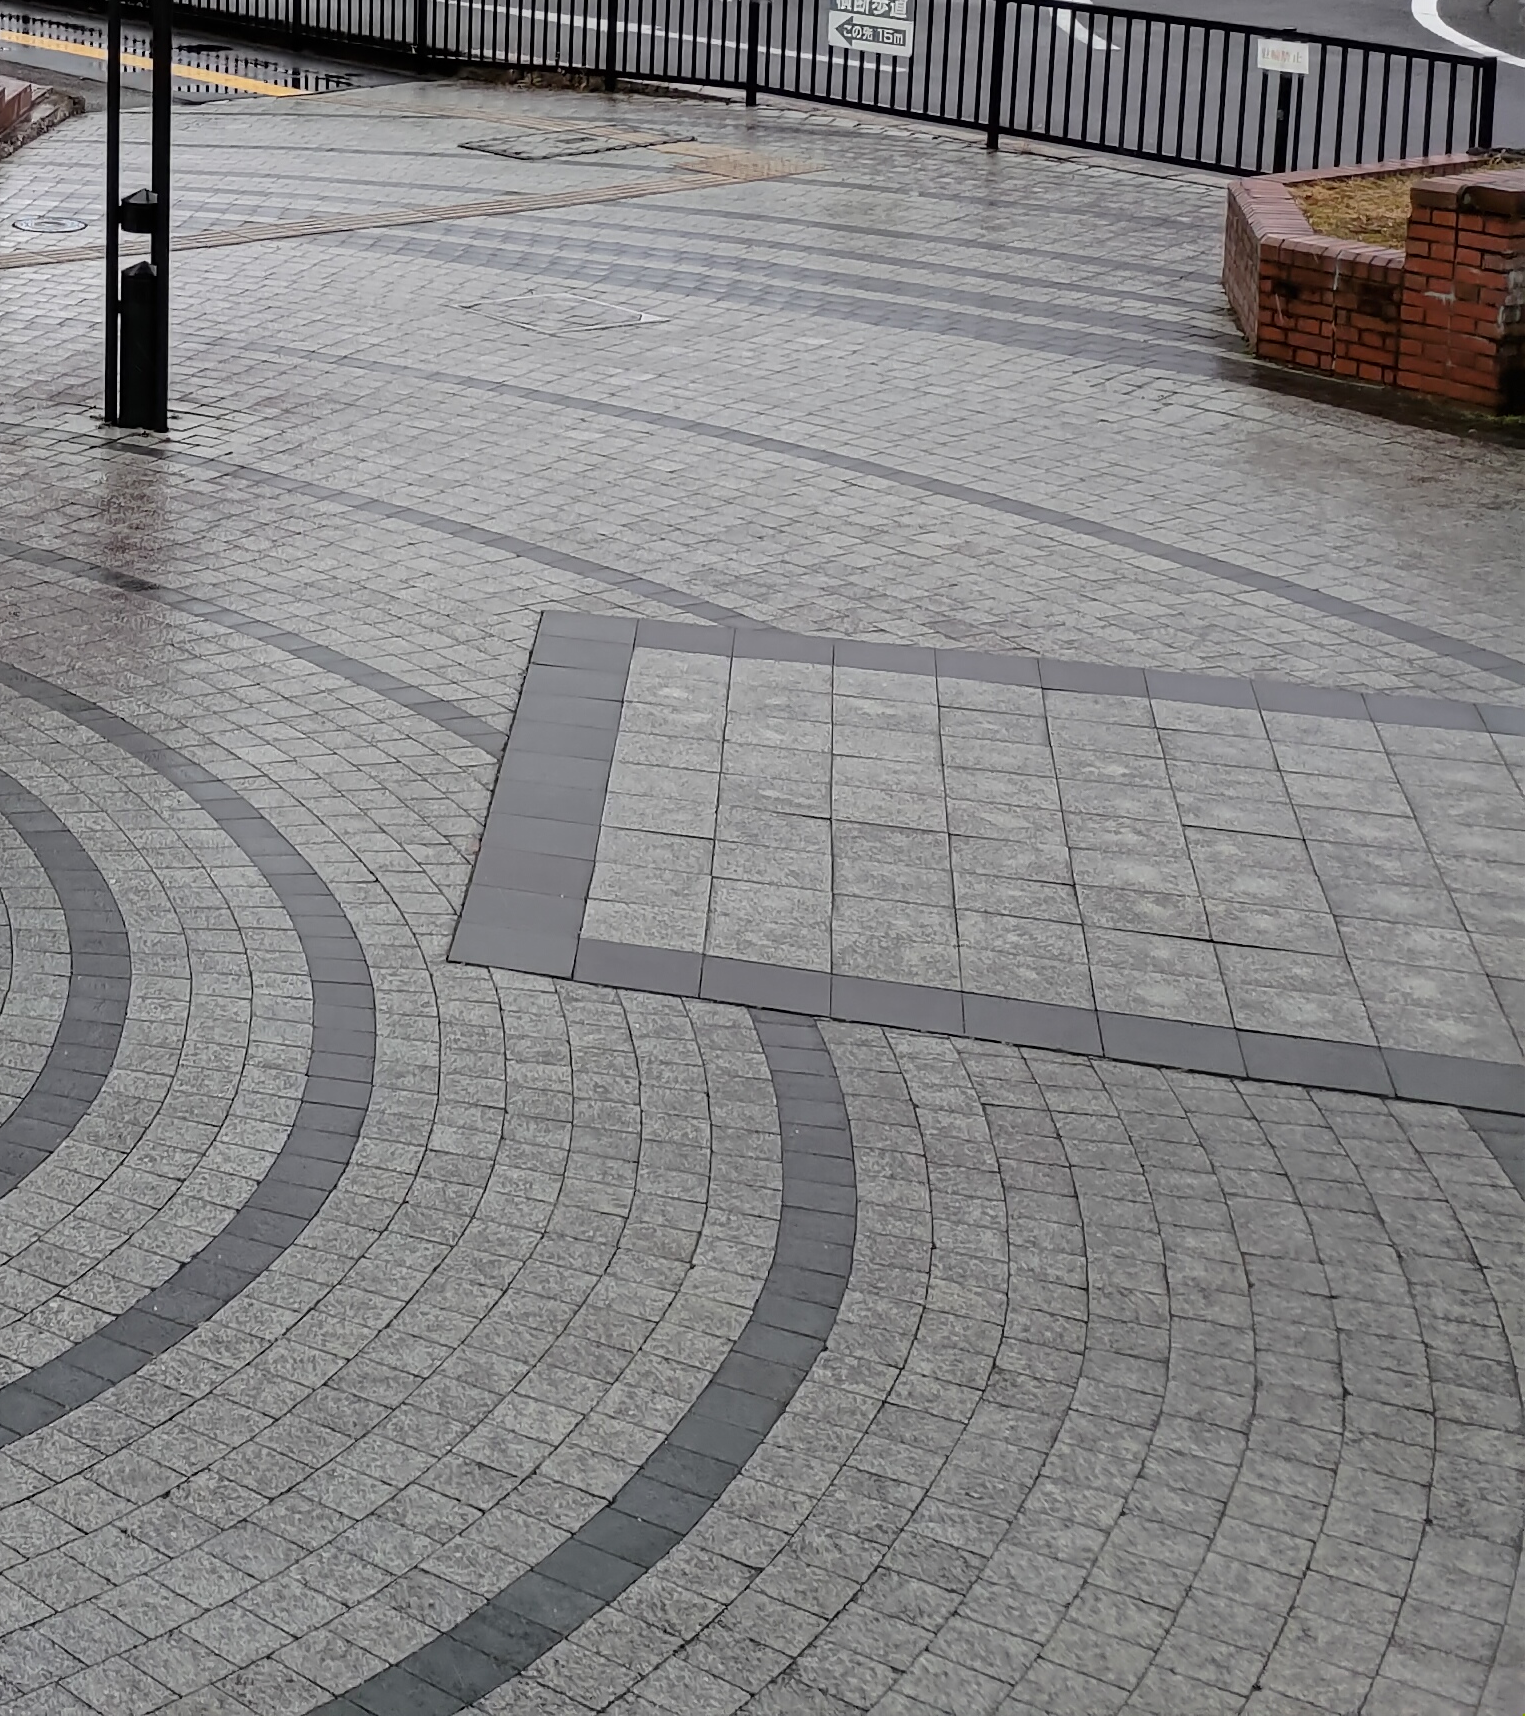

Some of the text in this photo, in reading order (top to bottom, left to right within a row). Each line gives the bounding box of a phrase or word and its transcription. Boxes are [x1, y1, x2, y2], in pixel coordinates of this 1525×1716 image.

[843, 24, 904, 45] この先 15m
